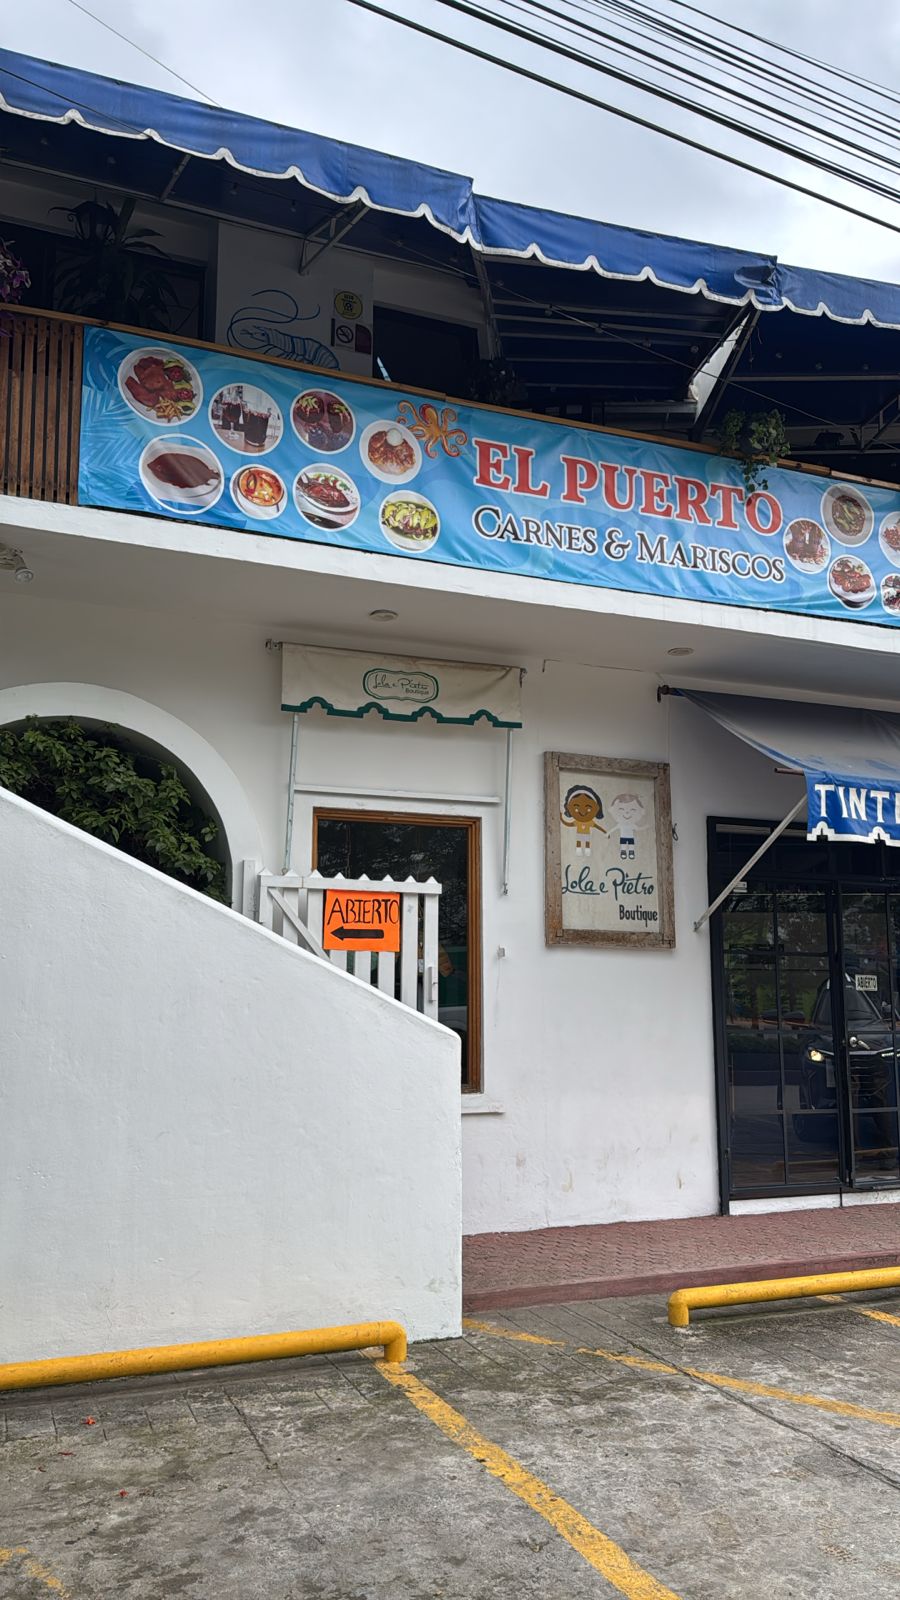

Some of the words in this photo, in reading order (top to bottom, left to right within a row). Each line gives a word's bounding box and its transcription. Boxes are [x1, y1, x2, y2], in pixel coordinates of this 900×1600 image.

[473, 438, 549, 498] EL
[560, 455, 783, 536] PUERTO
[473, 506, 597, 554] CARNES
[604, 529, 630, 559] &
[637, 532, 785, 582] MARISCOS
[562, 864, 600, 895] Lola
[599, 883, 608, 893] e
[606, 867, 654, 900] Pietro
[327, 897, 400, 925] ABIERTO
[619, 904, 658, 928] Boutique
[857, 976, 876, 989] ABIERTO
